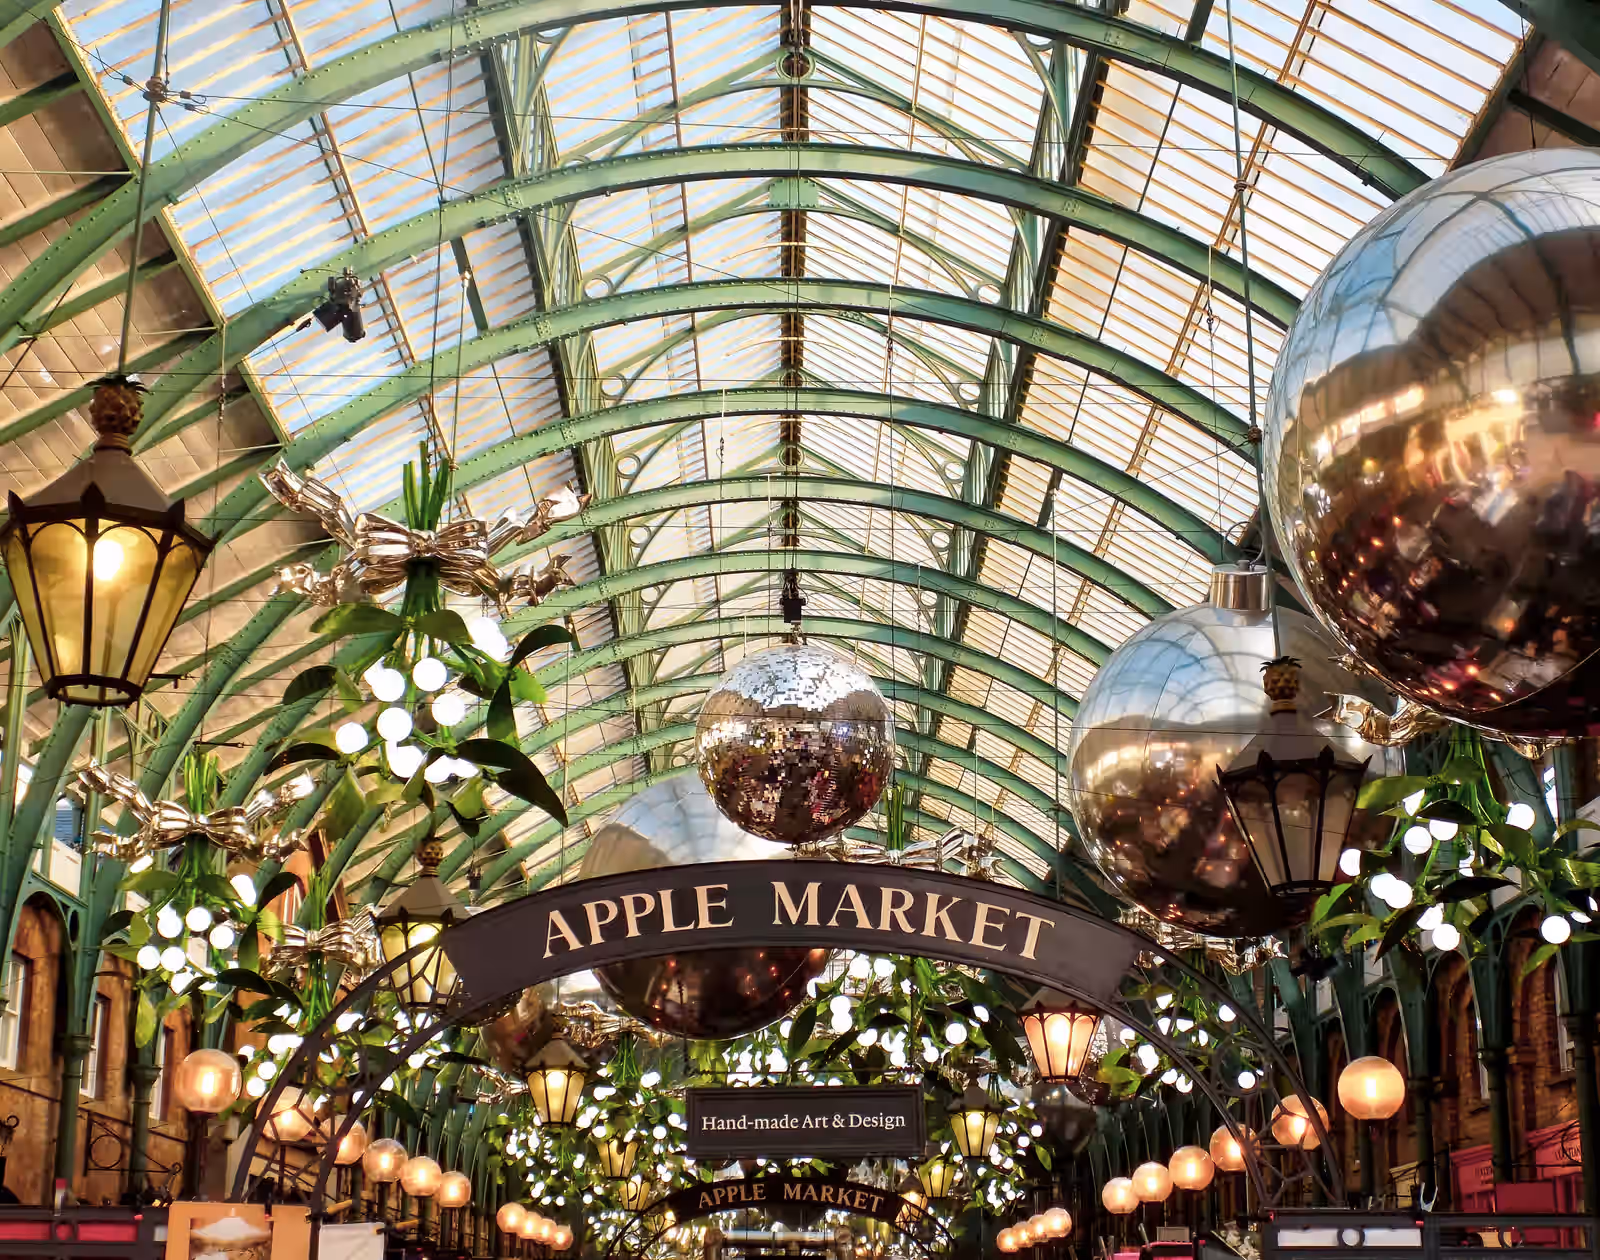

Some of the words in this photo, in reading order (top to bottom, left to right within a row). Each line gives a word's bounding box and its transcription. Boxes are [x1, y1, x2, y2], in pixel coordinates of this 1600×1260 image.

[542, 883, 735, 959] APPLE
[771, 881, 1056, 962] MARKET
[702, 1114, 799, 1131] Hand-made
[802, 1114, 828, 1129] Art
[832, 1112, 845, 1128] &
[848, 1112, 906, 1130] Design
[699, 1183, 766, 1209] APPLE
[783, 1183, 884, 1213] MARKET
